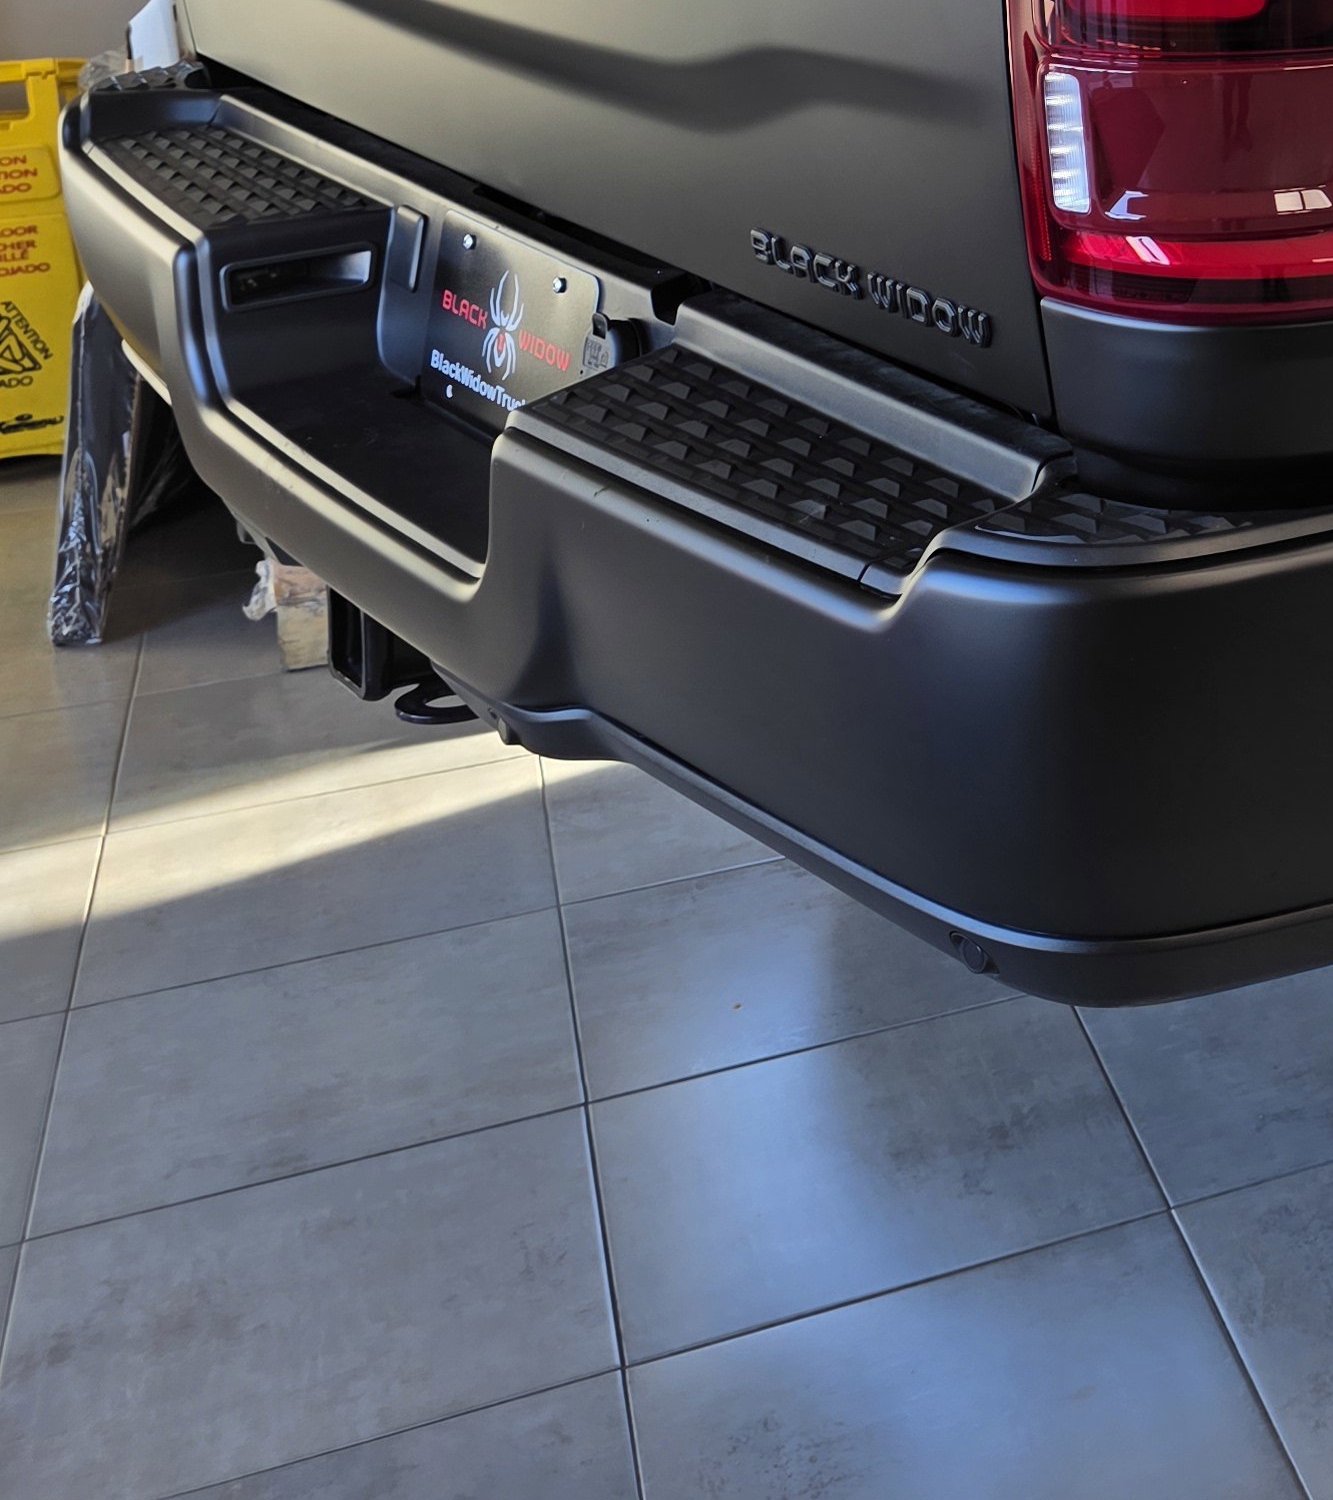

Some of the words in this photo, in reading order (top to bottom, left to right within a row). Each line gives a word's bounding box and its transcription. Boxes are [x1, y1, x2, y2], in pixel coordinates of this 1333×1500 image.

[750, 228, 864, 301] BLACK
[866, 271, 992, 349] WIDOW
[2, 301, 54, 360] ATTENTION
[442, 290, 488, 330] BLACK
[519, 330, 571, 372] WIDOW
